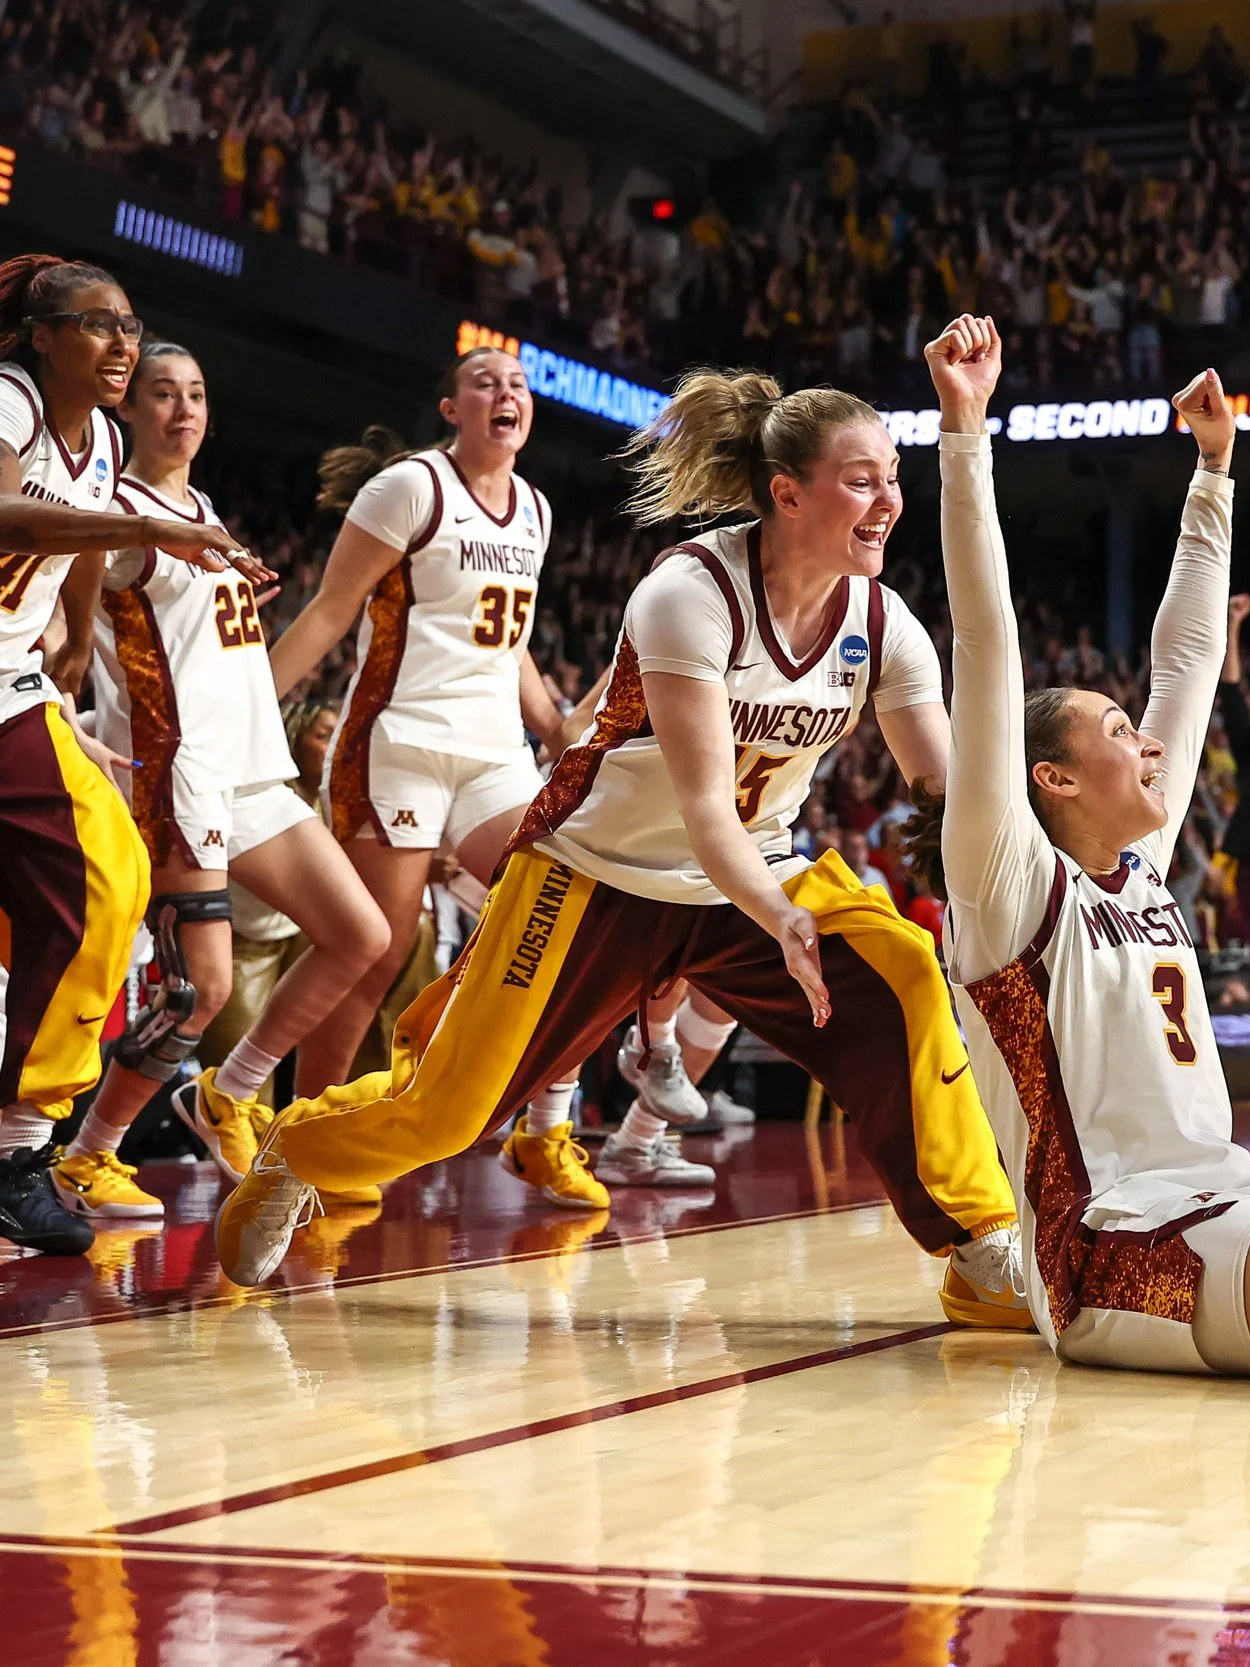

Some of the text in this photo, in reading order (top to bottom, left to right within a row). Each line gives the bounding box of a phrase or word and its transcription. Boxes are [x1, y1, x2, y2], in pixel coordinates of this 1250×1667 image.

[1006, 398, 1171, 441] SECOND
[459, 538, 538, 580] MINNESOT
[214, 581, 264, 652] 22
[471, 583, 533, 651] 35
[843, 648, 868, 657] NCAA
[728, 697, 851, 749] INNESOTA
[734, 743, 797, 827] 5
[501, 858, 574, 989] MINNESOTA
[1150, 961, 1197, 1067] 3
